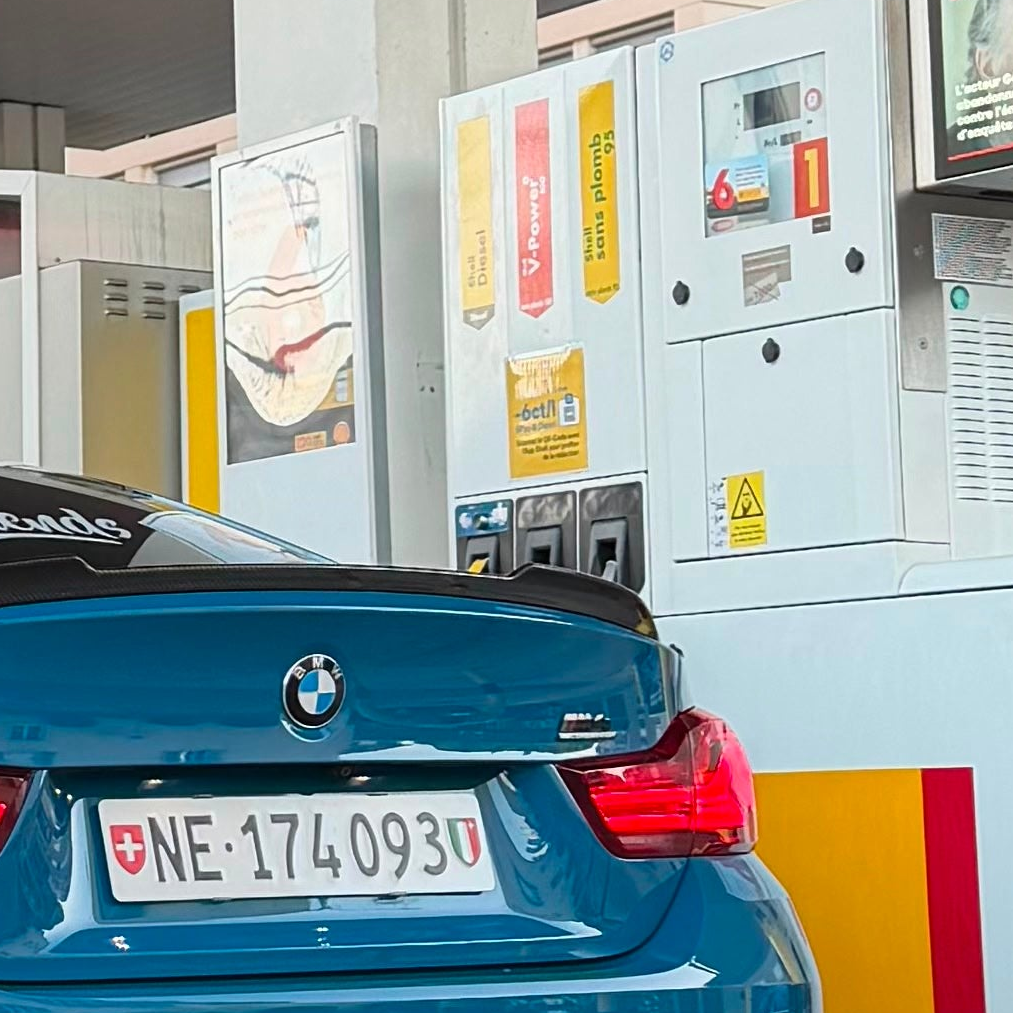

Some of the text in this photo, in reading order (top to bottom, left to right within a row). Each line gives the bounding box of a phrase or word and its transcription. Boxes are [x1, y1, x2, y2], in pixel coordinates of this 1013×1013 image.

[957, 110, 993, 126] contre
[603, 130, 615, 154] 95
[589, 133, 607, 260] sans plomb
[713, 168, 735, 210] 6
[804, 148, 819, 208] 1
[527, 177, 541, 276] V-Power
[583, 226, 594, 262] Shell
[476, 229, 488, 287] Diesel
[292, 656, 344, 680] BMW
